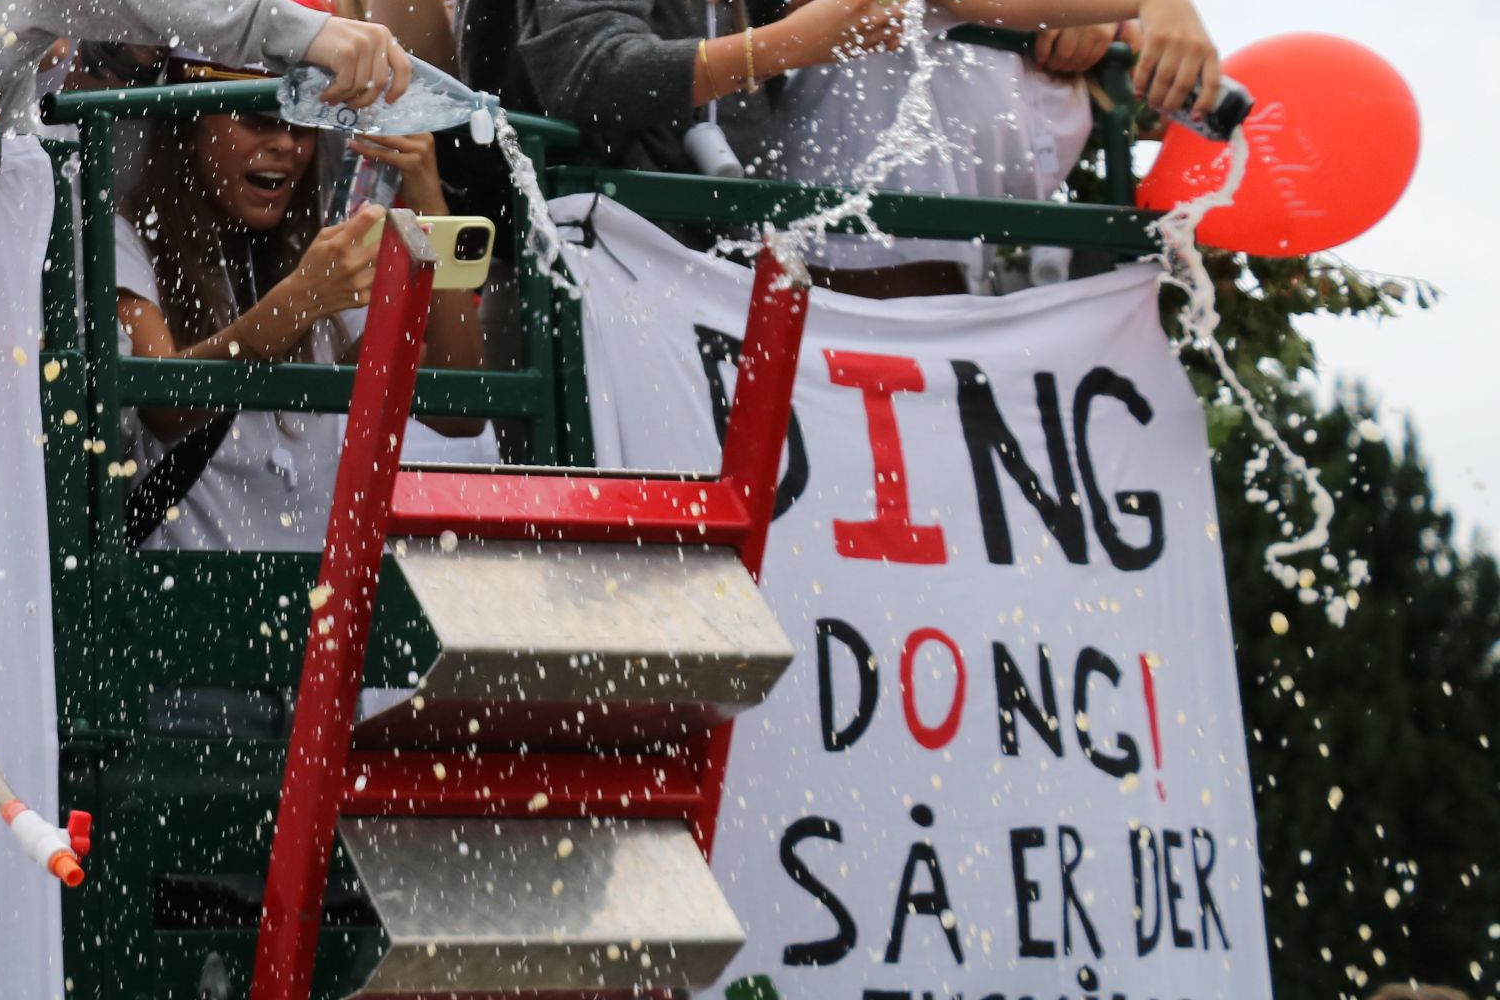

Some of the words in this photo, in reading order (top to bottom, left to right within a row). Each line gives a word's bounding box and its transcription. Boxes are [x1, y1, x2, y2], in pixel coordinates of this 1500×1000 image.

[815, 618, 1166, 803] DONG!
[779, 803, 964, 967] SÅ
[1008, 826, 1104, 959] ER
[1129, 826, 1231, 957] DER
